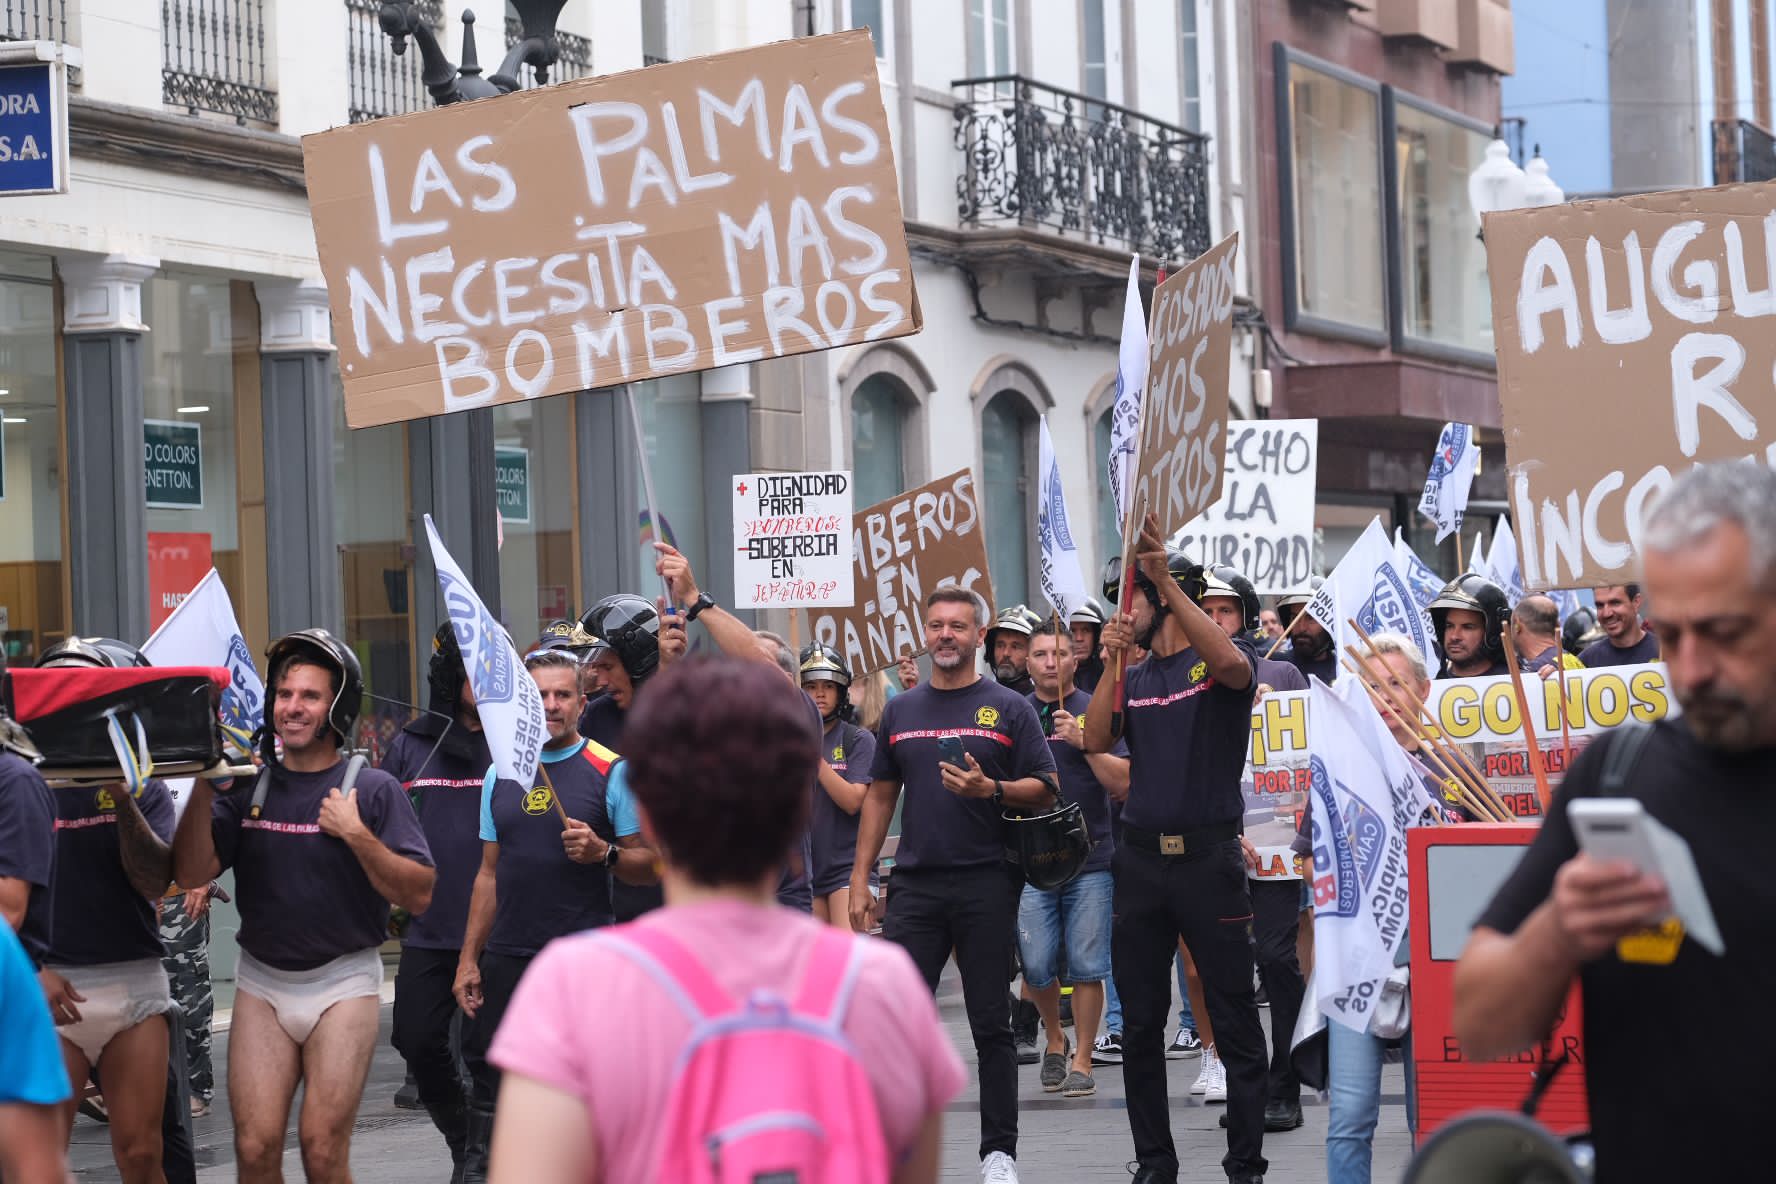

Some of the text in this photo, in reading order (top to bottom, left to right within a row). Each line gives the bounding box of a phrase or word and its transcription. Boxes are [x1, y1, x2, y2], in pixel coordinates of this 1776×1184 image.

[368, 76, 881, 247] LAS PALMAS
[345, 185, 888, 358] NECESITA MAS
[434, 268, 904, 412] BOMBEROS
[155, 444, 196, 464] COLORS
[757, 474, 847, 498] DIGNIDAD
[759, 497, 803, 516] PARA
[1225, 481, 1277, 524] LA
[748, 534, 838, 560] SOBERBIA
[771, 558, 794, 579] EN
[1543, 671, 1668, 732] NOS
[1486, 754, 1526, 777] POR
[1253, 769, 1292, 794] POR
[1502, 793, 1539, 816] DEL
